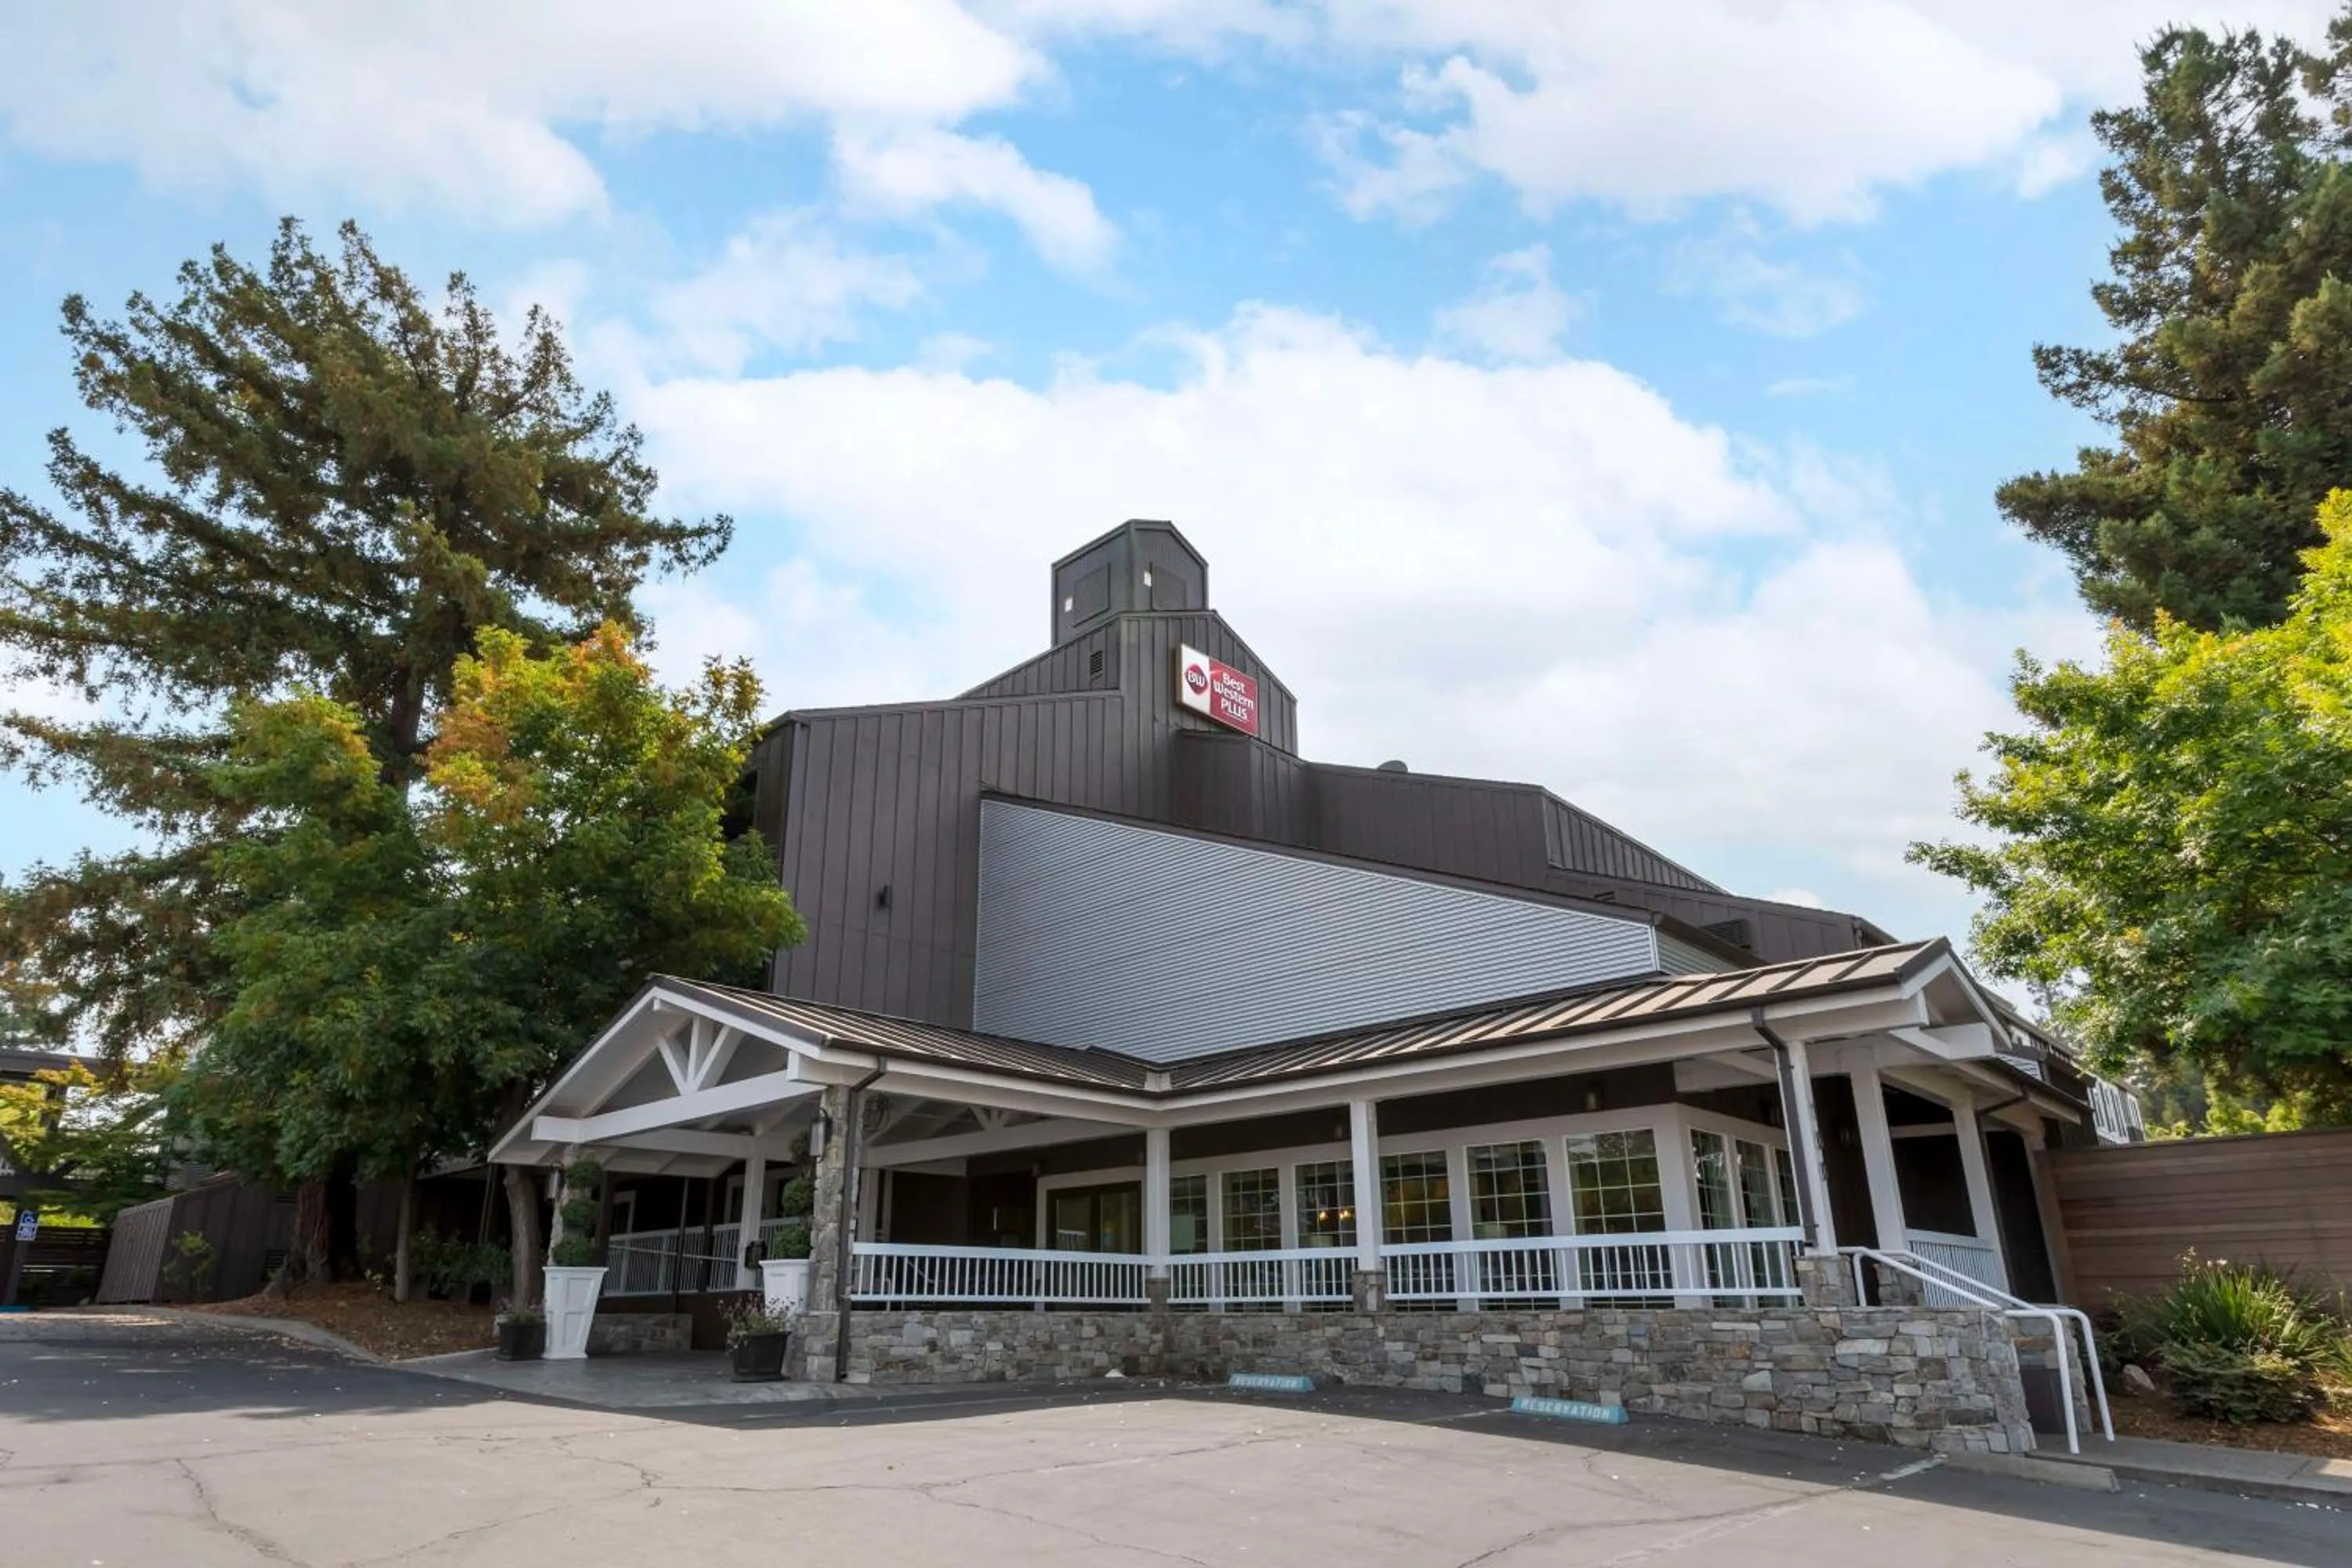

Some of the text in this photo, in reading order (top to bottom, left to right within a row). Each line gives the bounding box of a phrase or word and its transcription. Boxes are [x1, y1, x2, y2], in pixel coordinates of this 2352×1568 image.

[1223, 672, 1245, 693] Best
[1214, 679, 1254, 709] Western
[1221, 698, 1247, 720] PLUS
